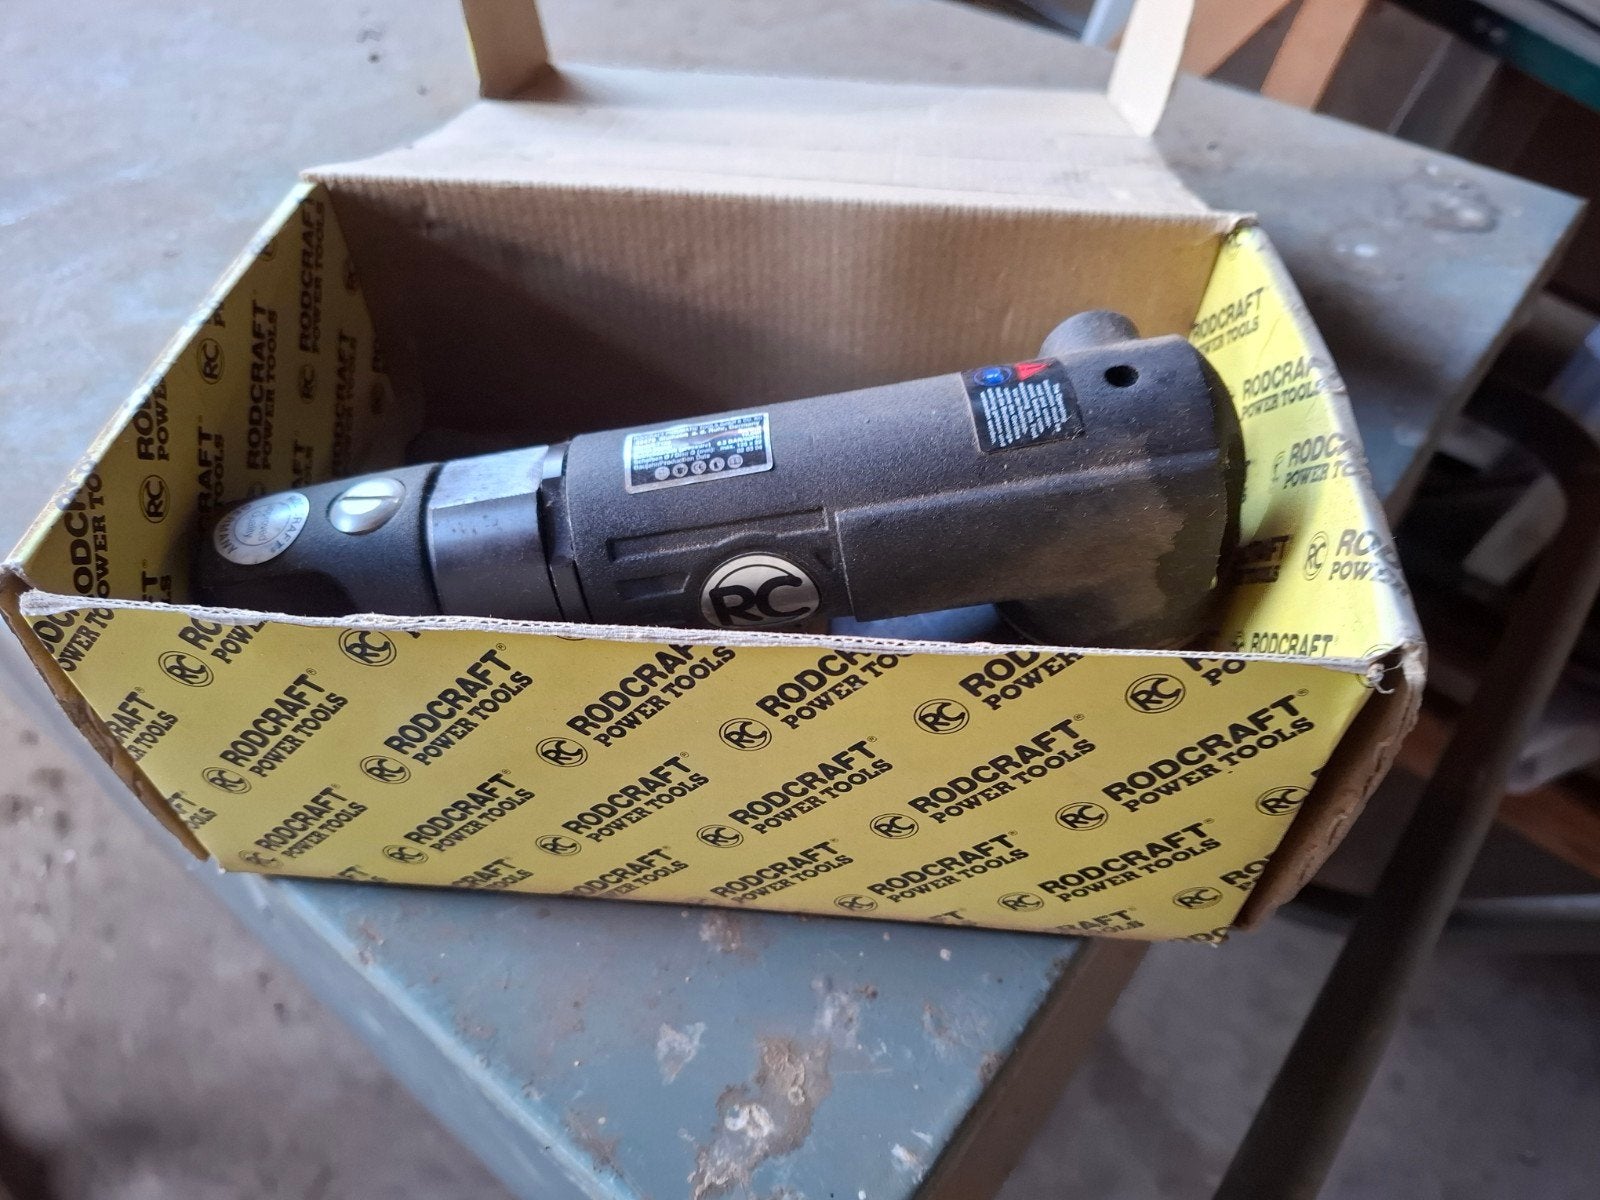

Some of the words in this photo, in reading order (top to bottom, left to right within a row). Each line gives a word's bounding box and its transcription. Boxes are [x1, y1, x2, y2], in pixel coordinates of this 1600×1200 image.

[200, 343, 222, 380] RC
[155, 374, 170, 461] POWE
[145, 479, 166, 518] RC
[1303, 542, 1328, 570] RC
[709, 575, 811, 626] RC
[165, 654, 208, 685] RC
[343, 630, 392, 664] RC
[1251, 632, 1333, 657] RODCRAFT
[219, 673, 325, 767] RODCRAFT
[383, 649, 511, 755] RODCRAFT
[412, 717, 479, 766] POWER
[467, 671, 533, 720] TOOLS
[593, 695, 671, 747] POWER
[660, 646, 736, 698] TOOLS
[780, 674, 868, 730] POWER
[917, 701, 967, 733] RC
[1128, 676, 1184, 712] RC
[134, 710, 179, 748] TOOLS
[249, 734, 305, 778] POWER
[291, 692, 349, 737] TOOLS
[540, 739, 584, 766] RC
[722, 720, 769, 750] RC
[1102, 694, 1299, 802] RODCRAFT
[208, 769, 247, 792] RC
[364, 757, 407, 782] RC
[728, 740, 875, 825] RODCRAFT
[908, 719, 1079, 814] RODCRAFT
[929, 781, 1017, 824] POWER
[1010, 739, 1096, 785] TOOLS
[1121, 763, 1222, 813] POWER
[1218, 717, 1315, 766] TOOLS
[254, 787, 348, 851] RODCRAFT
[403, 773, 516, 844] RODCRAFT
[429, 820, 488, 853] POWER
[478, 788, 535, 822] TOOLS
[561, 756, 691, 834] RODCRAFT
[586, 806, 653, 843] POWER
[644, 773, 709, 810] TOOLS
[751, 795, 826, 834] POWER
[819, 759, 893, 799] TOOLS
[1057, 804, 1107, 830] RC
[281, 830, 329, 859] POWER
[319, 801, 368, 833] TOOLS
[386, 845, 424, 863] RC
[539, 836, 579, 855] RC
[699, 826, 742, 847] RC
[872, 815, 918, 839] RC
[632, 859, 689, 888] TOOLS
[710, 841, 839, 898] RODCRAFT
[791, 855, 853, 882] TOOLS
[867, 834, 1014, 896] RODCRAFT
[887, 875, 961, 903] POWER
[956, 849, 1029, 879] TOOLS
[1037, 822, 1210, 894] RODCRAFT
[1056, 870, 1142, 902] POWER
[1138, 838, 1221, 874] TOOLS
[998, 894, 1043, 912] RC
[1176, 888, 1221, 909] RC
